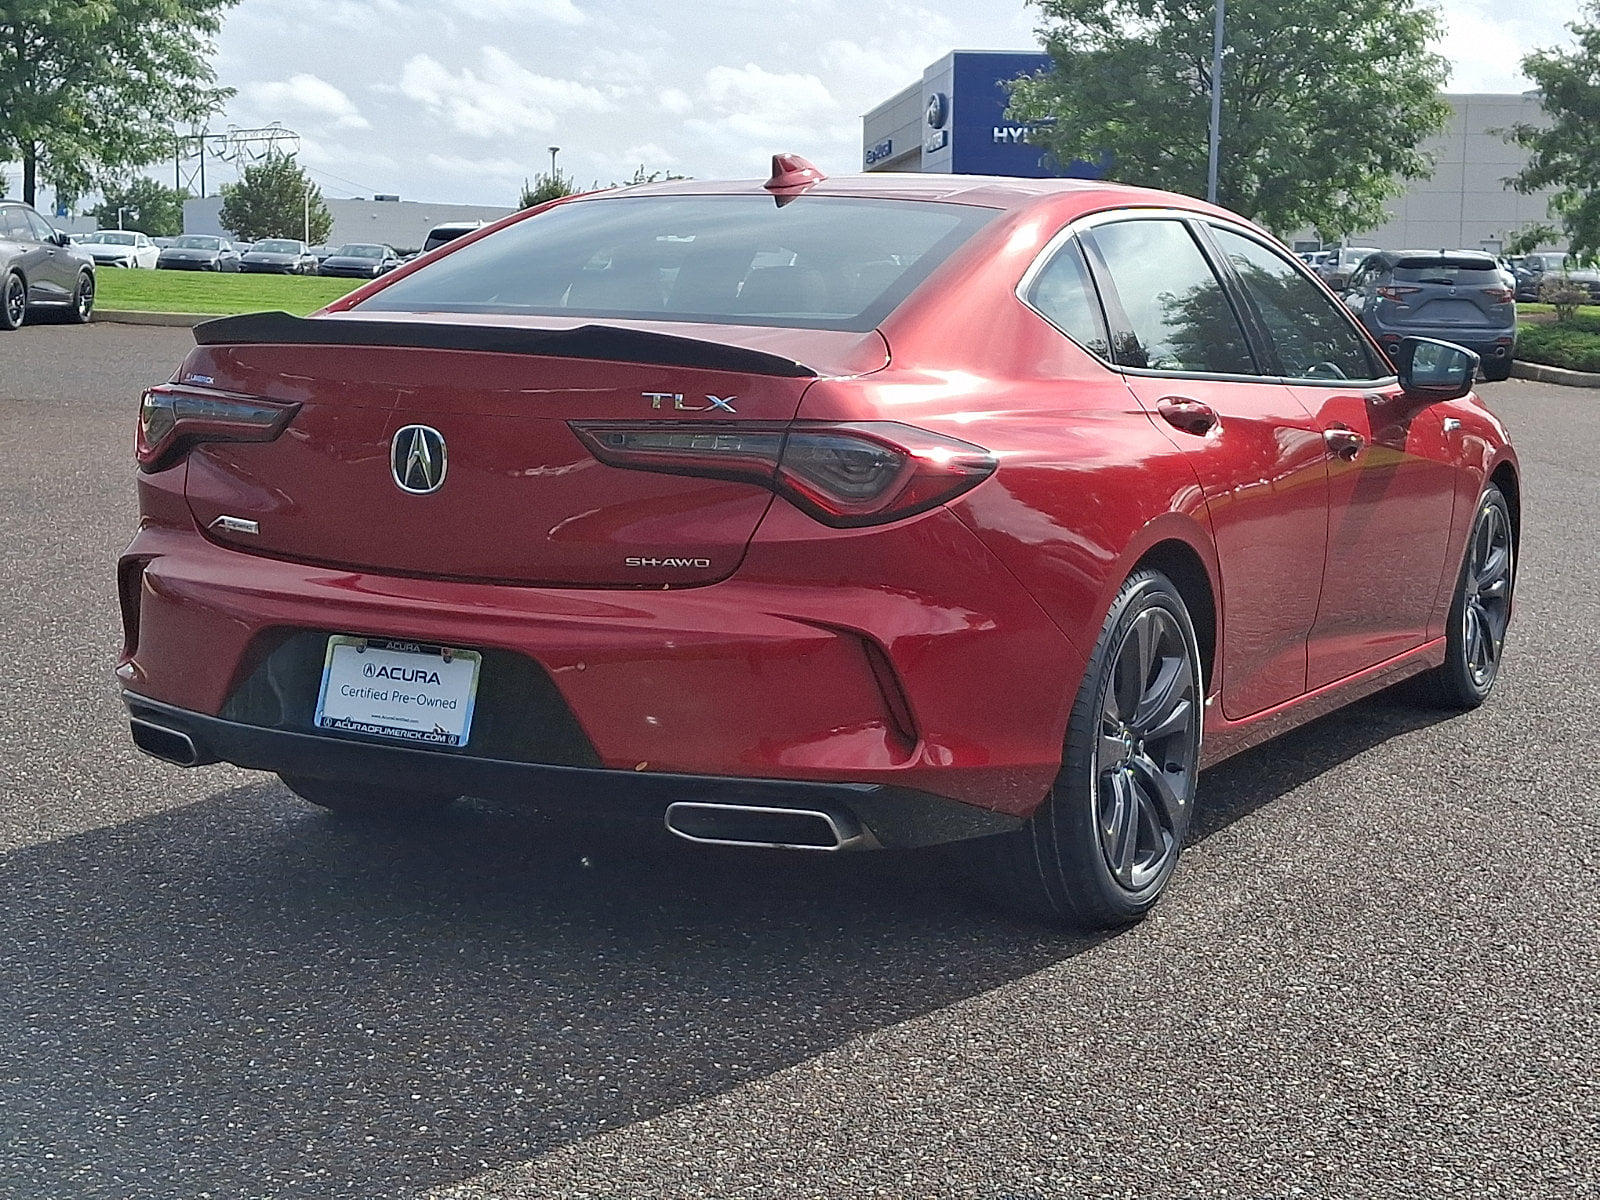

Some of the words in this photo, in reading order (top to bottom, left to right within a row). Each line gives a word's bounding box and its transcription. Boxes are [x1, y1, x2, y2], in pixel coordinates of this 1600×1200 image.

[641, 392, 738, 413] TLX
[625, 557, 711, 568] SH-AWD
[386, 641, 421, 652] ACURA
[375, 666, 441, 685] ACURA
[341, 684, 389, 701] Certified
[391, 690, 457, 710] Pre-Owned
